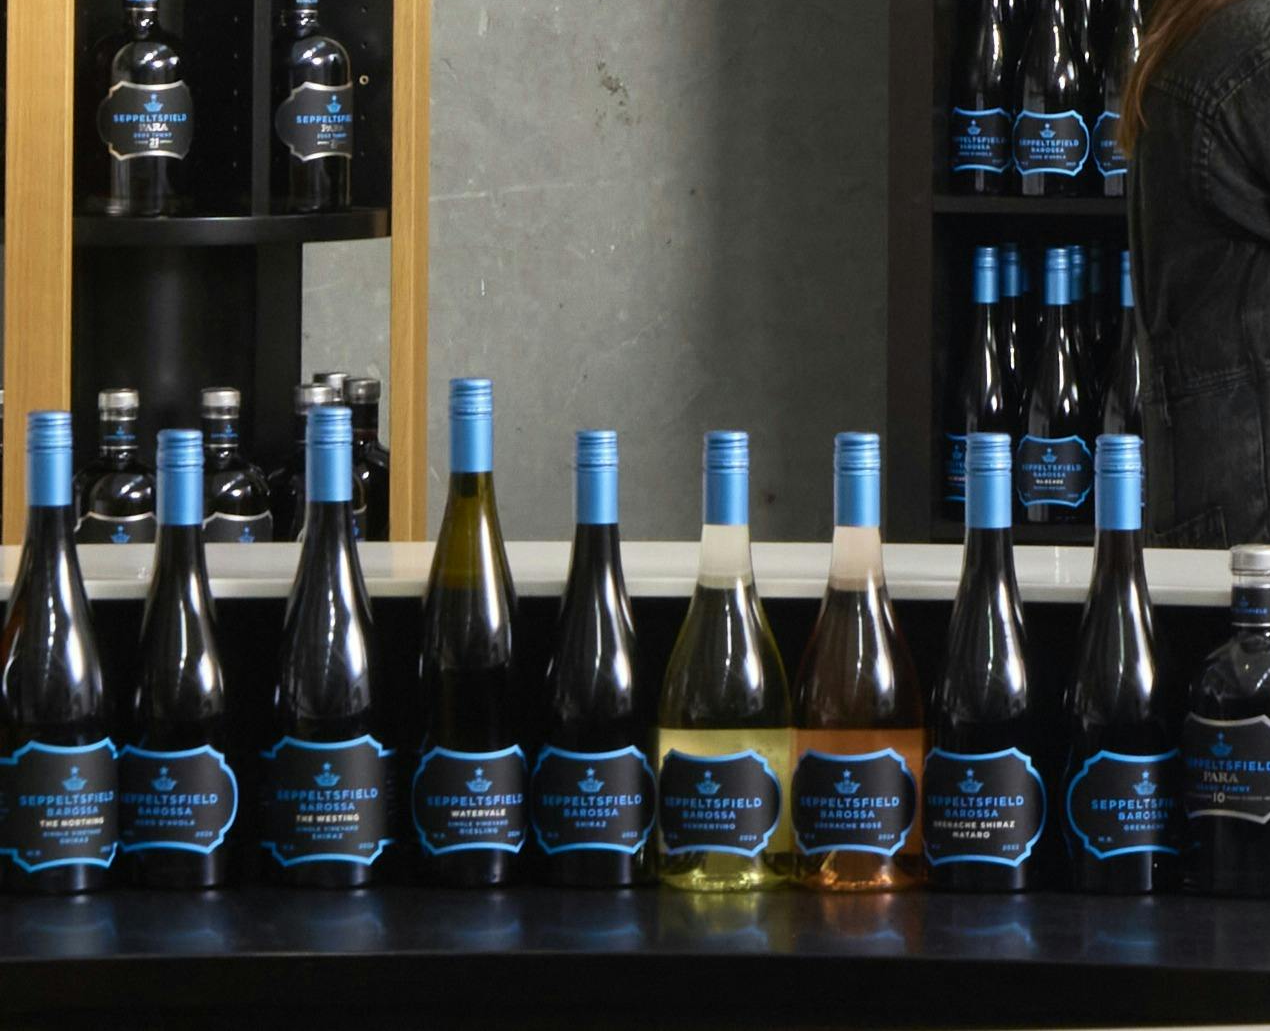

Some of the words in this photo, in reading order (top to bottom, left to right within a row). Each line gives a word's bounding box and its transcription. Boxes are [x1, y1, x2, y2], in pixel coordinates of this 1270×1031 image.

[113, 114, 187, 123] SEPPELTSFIELD
[1203, 770, 1239, 783] PARA
[19, 790, 115, 807] SEPPELTSFIELD
[276, 788, 378, 801] SEPPELTSFIELD
[427, 793, 523, 806] SEPPELTSFIELD
[543, 794, 642, 806] SEPPELTSFIELD
[1213, 791, 1225, 803] 10
[300, 801, 356, 812] BAROSSA
[800, 797, 900, 808] SEPPELTSFIELD
[47, 805, 99, 817] BAROSSA
[138, 806, 192, 816] BAROSSA
[451, 808, 506, 818] WATERVALE
[563, 807, 619, 817] BAROSSA
[681, 810, 737, 819] BAROSSA
[820, 810, 875, 819] BAROSSA
[944, 809, 999, 818] BAROSSA
[296, 814, 314, 823] THE
[316, 812, 360, 822] WESTING
[980, 820, 1016, 829] SHIRAZ
[952, 831, 991, 839] MATARO
